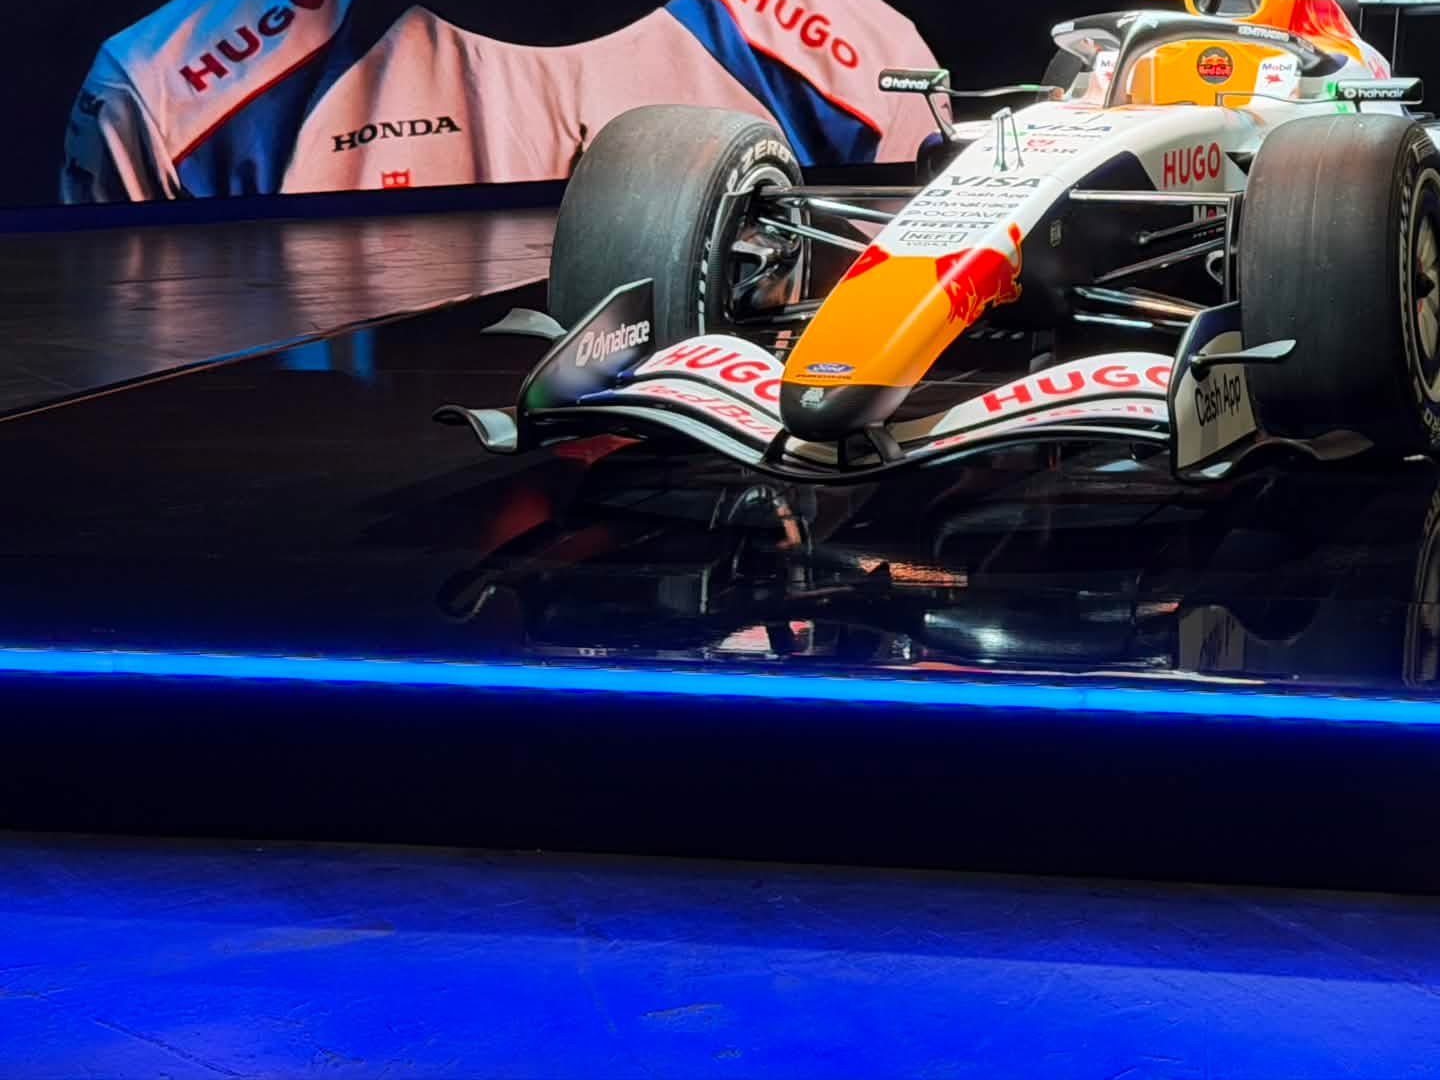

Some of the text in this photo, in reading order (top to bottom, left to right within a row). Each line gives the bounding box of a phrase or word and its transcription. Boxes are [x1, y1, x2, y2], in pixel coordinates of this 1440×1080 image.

[1262, 63, 1292, 72] Mobil
[892, 77, 930, 90] hahnair
[1358, 88, 1404, 98] hahnair
[332, 116, 461, 152] HONDA
[1027, 124, 1112, 132] VISA
[741, 139, 792, 173] ZERO
[1163, 142, 1221, 188] HUGO
[951, 176, 1040, 188] VISA
[957, 189, 1029, 200] Cash App
[932, 200, 1019, 209] dynatrace
[908, 232, 961, 240] NEFT
[592, 320, 650, 361] dynatrace
[1196, 383, 1221, 427] Cash
[1221, 373, 1241, 413] App
